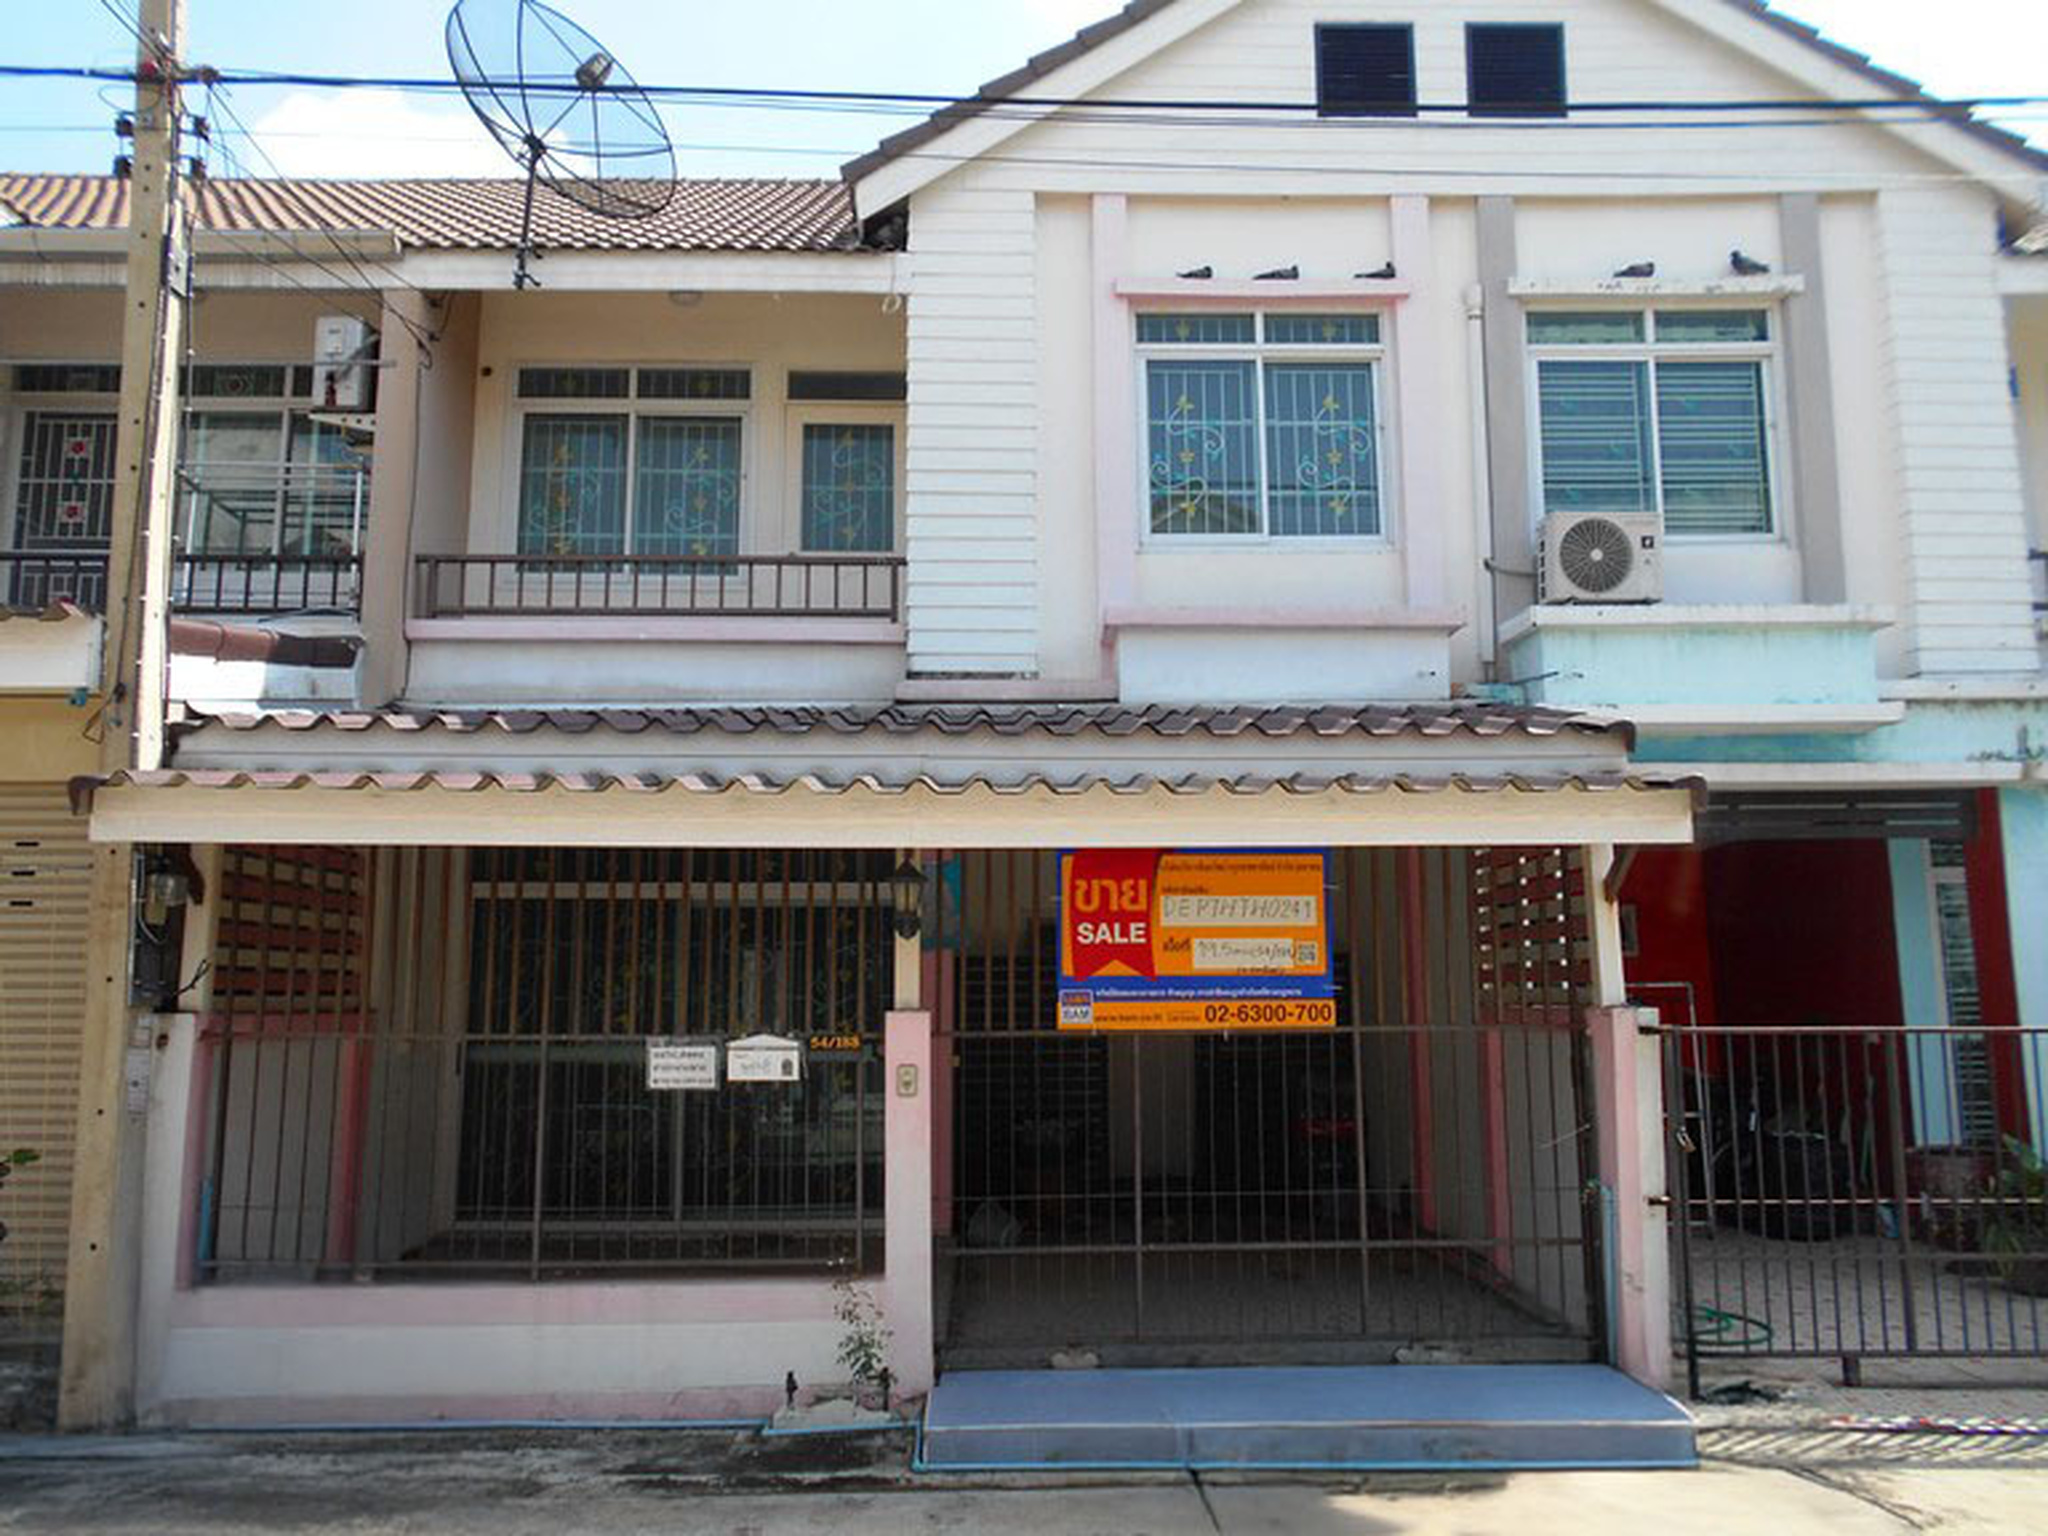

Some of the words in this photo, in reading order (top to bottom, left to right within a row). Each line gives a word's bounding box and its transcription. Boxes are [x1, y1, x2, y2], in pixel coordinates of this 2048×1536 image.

[1075, 878, 1148, 912] ขาย
[1077, 922, 1147, 944] SALE
[1205, 1003, 1332, 1023] 02-6300-700
